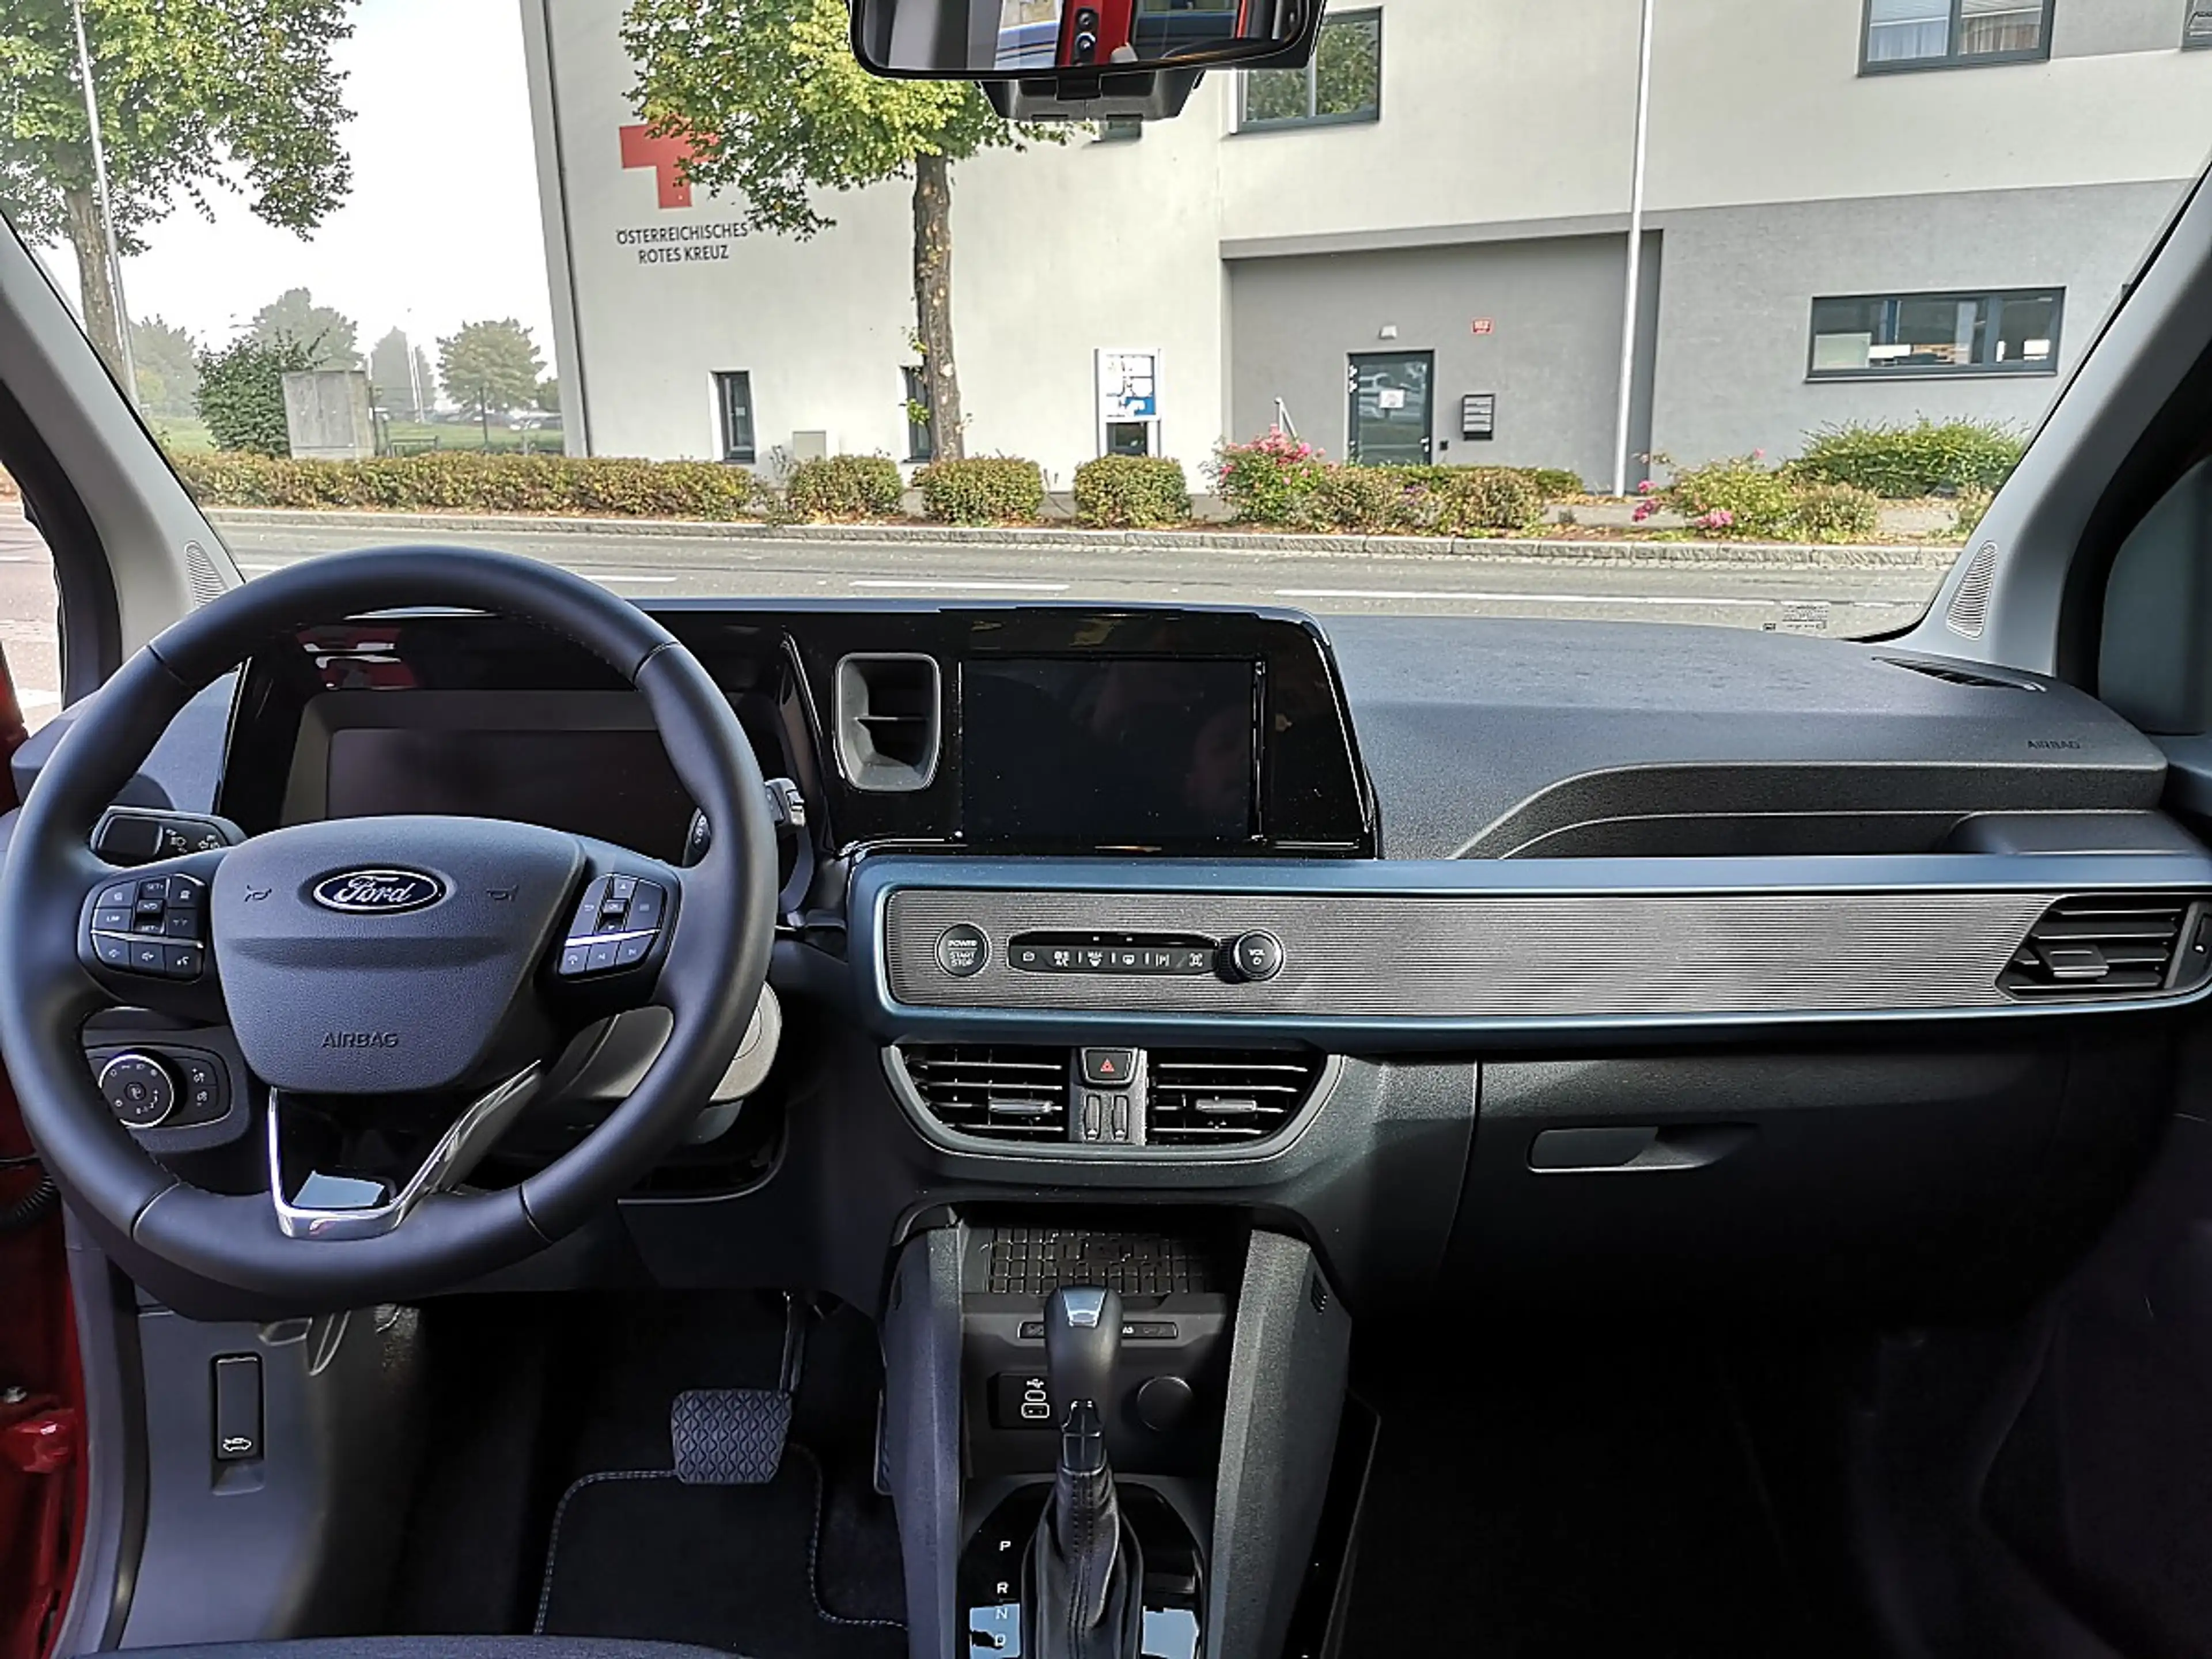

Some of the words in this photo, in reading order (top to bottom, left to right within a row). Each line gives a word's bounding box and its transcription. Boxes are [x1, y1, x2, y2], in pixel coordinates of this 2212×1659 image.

[616, 222, 748, 245] ÖSTERREICHISCHES
[638, 248, 681, 264] ROTES
[685, 245, 729, 260] KREUZ
[333, 875, 416, 903] Ford
[321, 1031, 399, 1048] AIRBAG
[999, 1540, 1012, 1551] P
[997, 1581, 1009, 1594] R
[995, 1607, 1008, 1620] N
